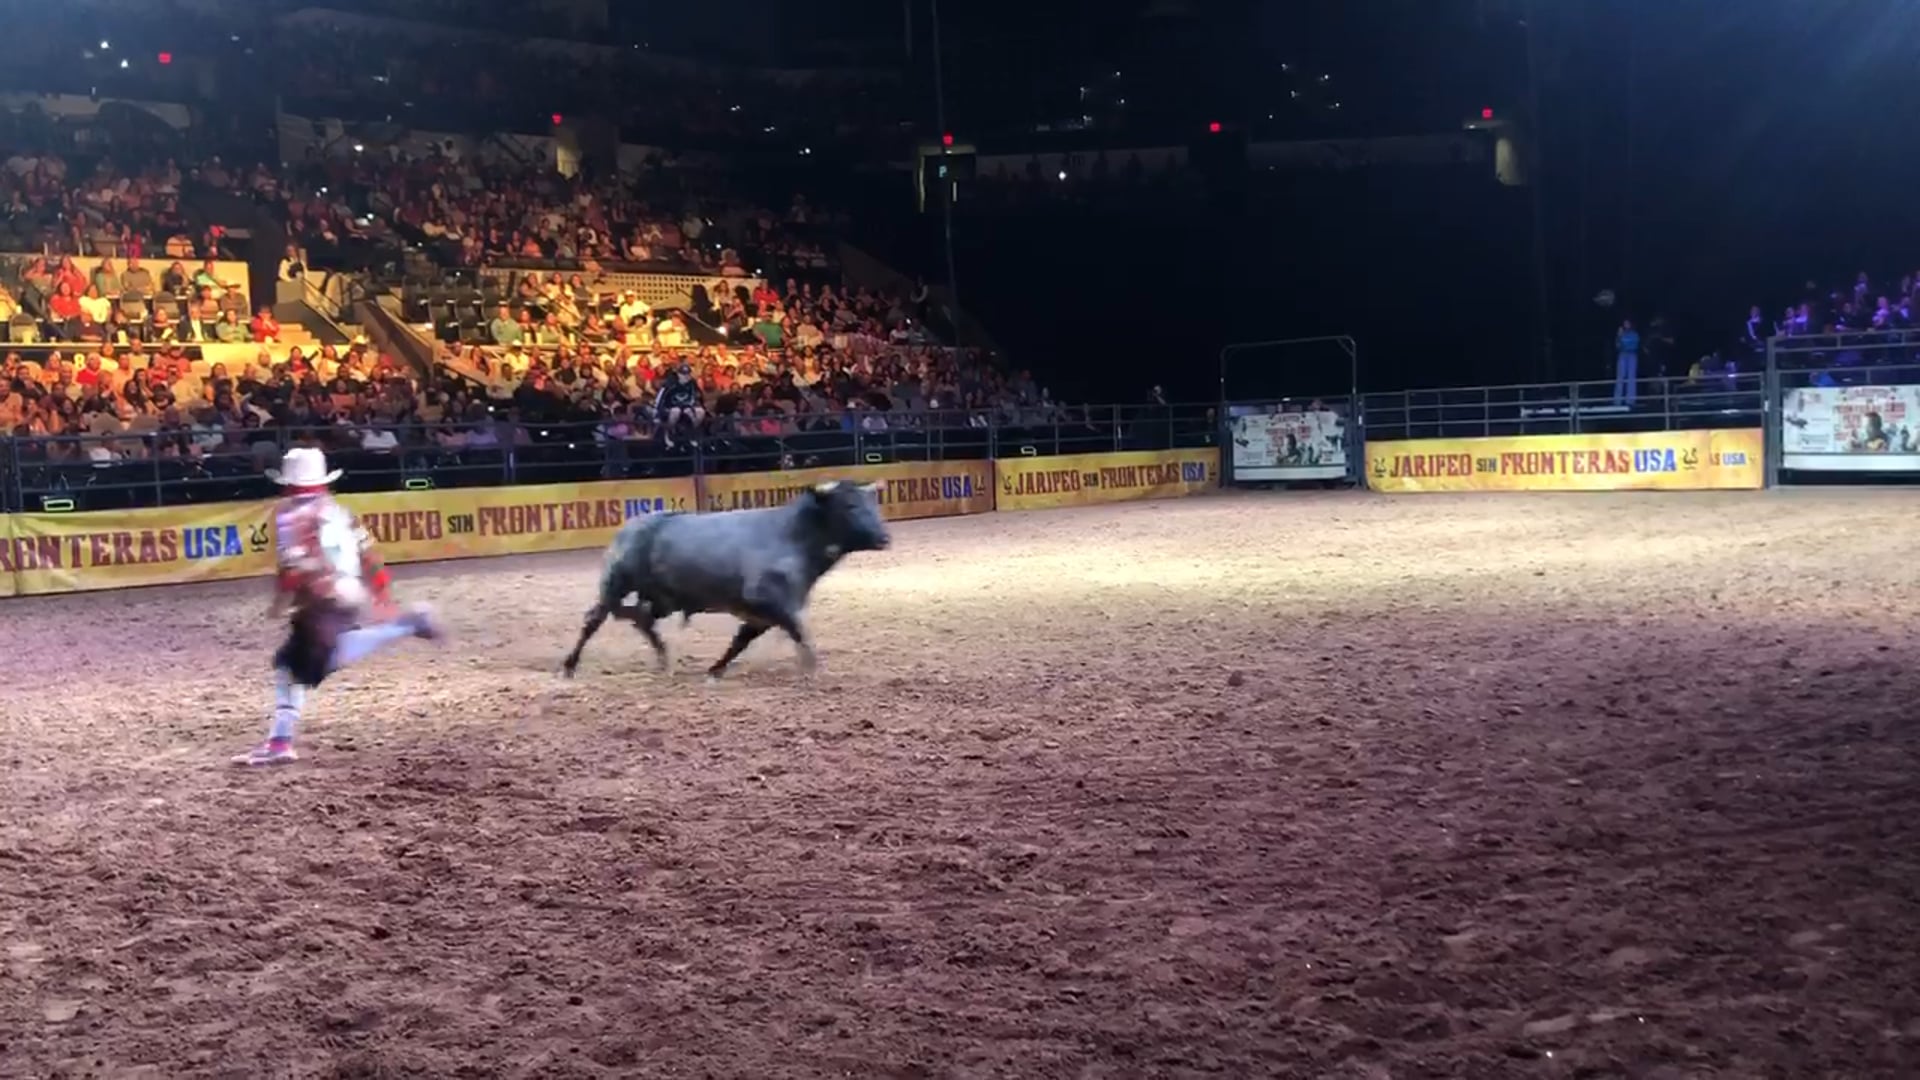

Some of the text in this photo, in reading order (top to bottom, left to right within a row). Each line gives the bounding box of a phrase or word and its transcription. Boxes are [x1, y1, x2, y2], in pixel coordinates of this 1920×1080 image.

[1015, 469, 1081, 496] JARIPEO
[1101, 462, 1180, 490] FRONTERAS
[1390, 448, 1677, 478] JARIPEO SIN FRONTERAS USA
[942, 474, 973, 499] USA
[353, 509, 442, 544] RIPEO
[447, 513, 473, 535] SIN
[478, 498, 622, 538] FRONTERAS
[183, 524, 243, 560] USA
